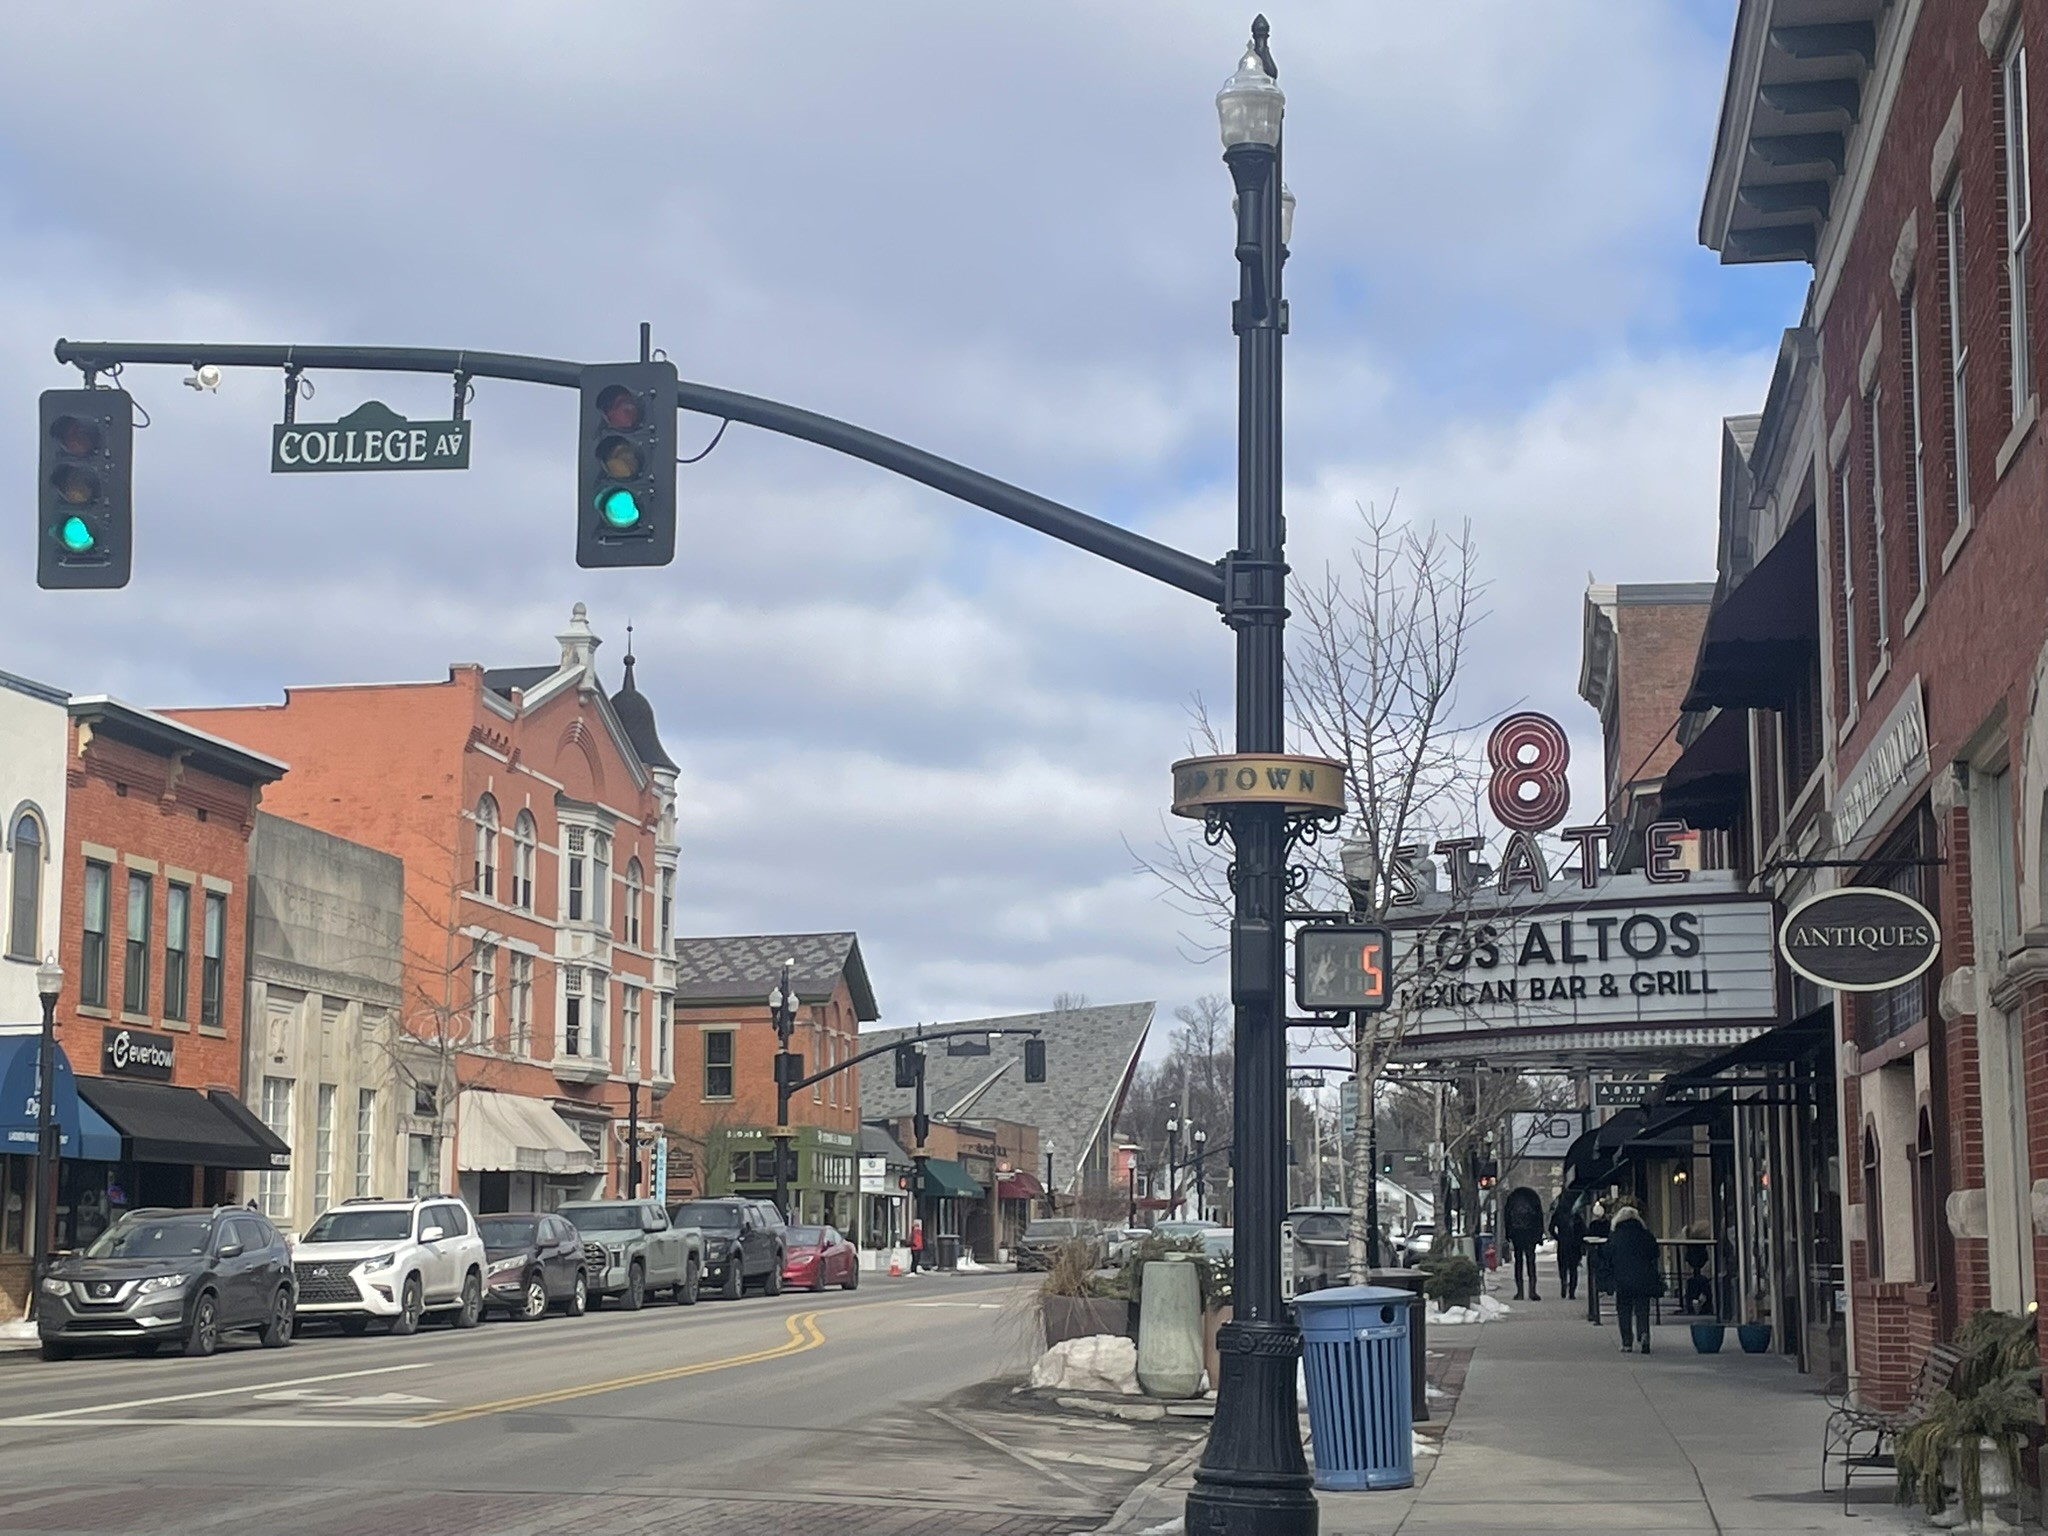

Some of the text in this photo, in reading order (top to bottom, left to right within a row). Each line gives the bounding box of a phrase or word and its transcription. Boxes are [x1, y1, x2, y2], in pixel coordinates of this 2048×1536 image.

[279, 430, 427, 464] COLLEGE
[1488, 711, 1571, 832] 8
[1390, 818, 1691, 906] STATE
[1518, 911, 1701, 967] ALTOS
[1792, 926, 1928, 951] ANTIQUES
[1362, 945, 1382, 996] 5
[1529, 974, 1587, 1001] BAR
[1599, 973, 1619, 998] &
[1630, 969, 1719, 996] GRILL
